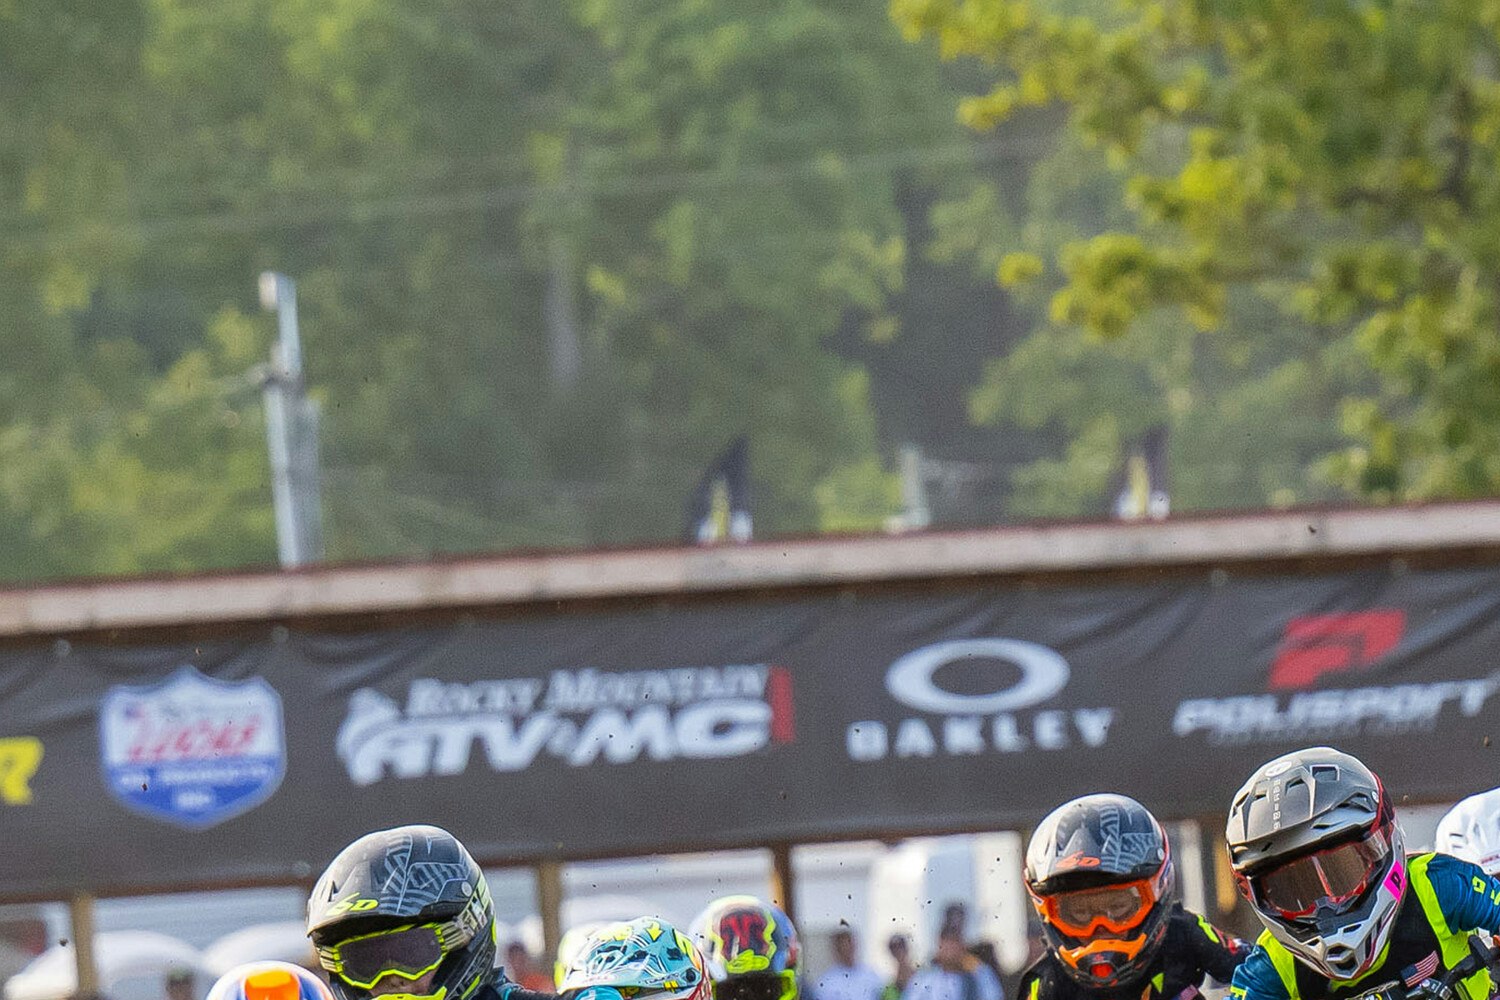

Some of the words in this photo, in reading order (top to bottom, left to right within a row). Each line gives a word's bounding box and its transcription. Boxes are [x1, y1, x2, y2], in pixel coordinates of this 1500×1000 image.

[405, 677, 543, 716] ROCKY
[545, 663, 768, 710] MOUNTAIN
[846, 706, 1113, 761] OAKLEY
